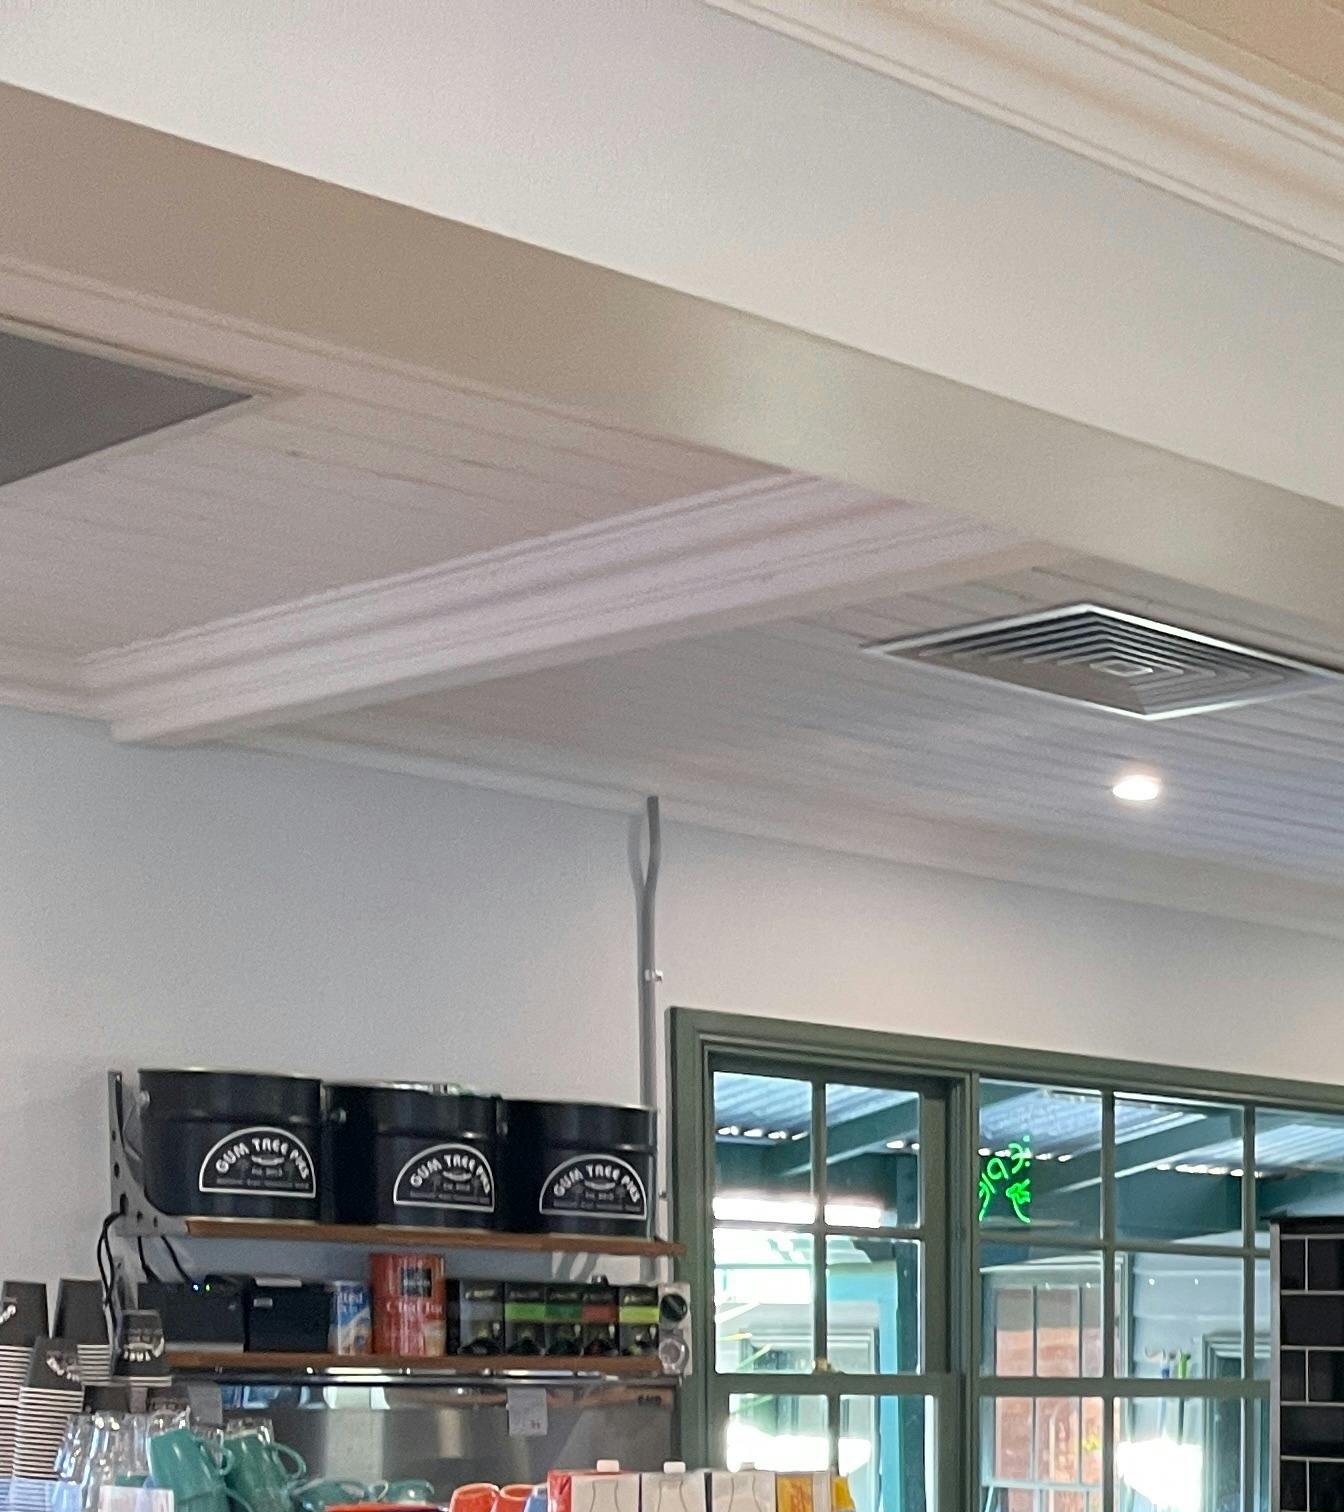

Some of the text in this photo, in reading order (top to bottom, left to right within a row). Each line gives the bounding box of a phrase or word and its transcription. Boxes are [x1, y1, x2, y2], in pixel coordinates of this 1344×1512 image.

[216, 1142, 250, 1174] GUM
[252, 1138, 289, 1155] TREE
[410, 1158, 442, 1187] GUM
[444, 1154, 476, 1172] TREE
[554, 1167, 584, 1197] GUM
[585, 1165, 621, 1180] TREE
